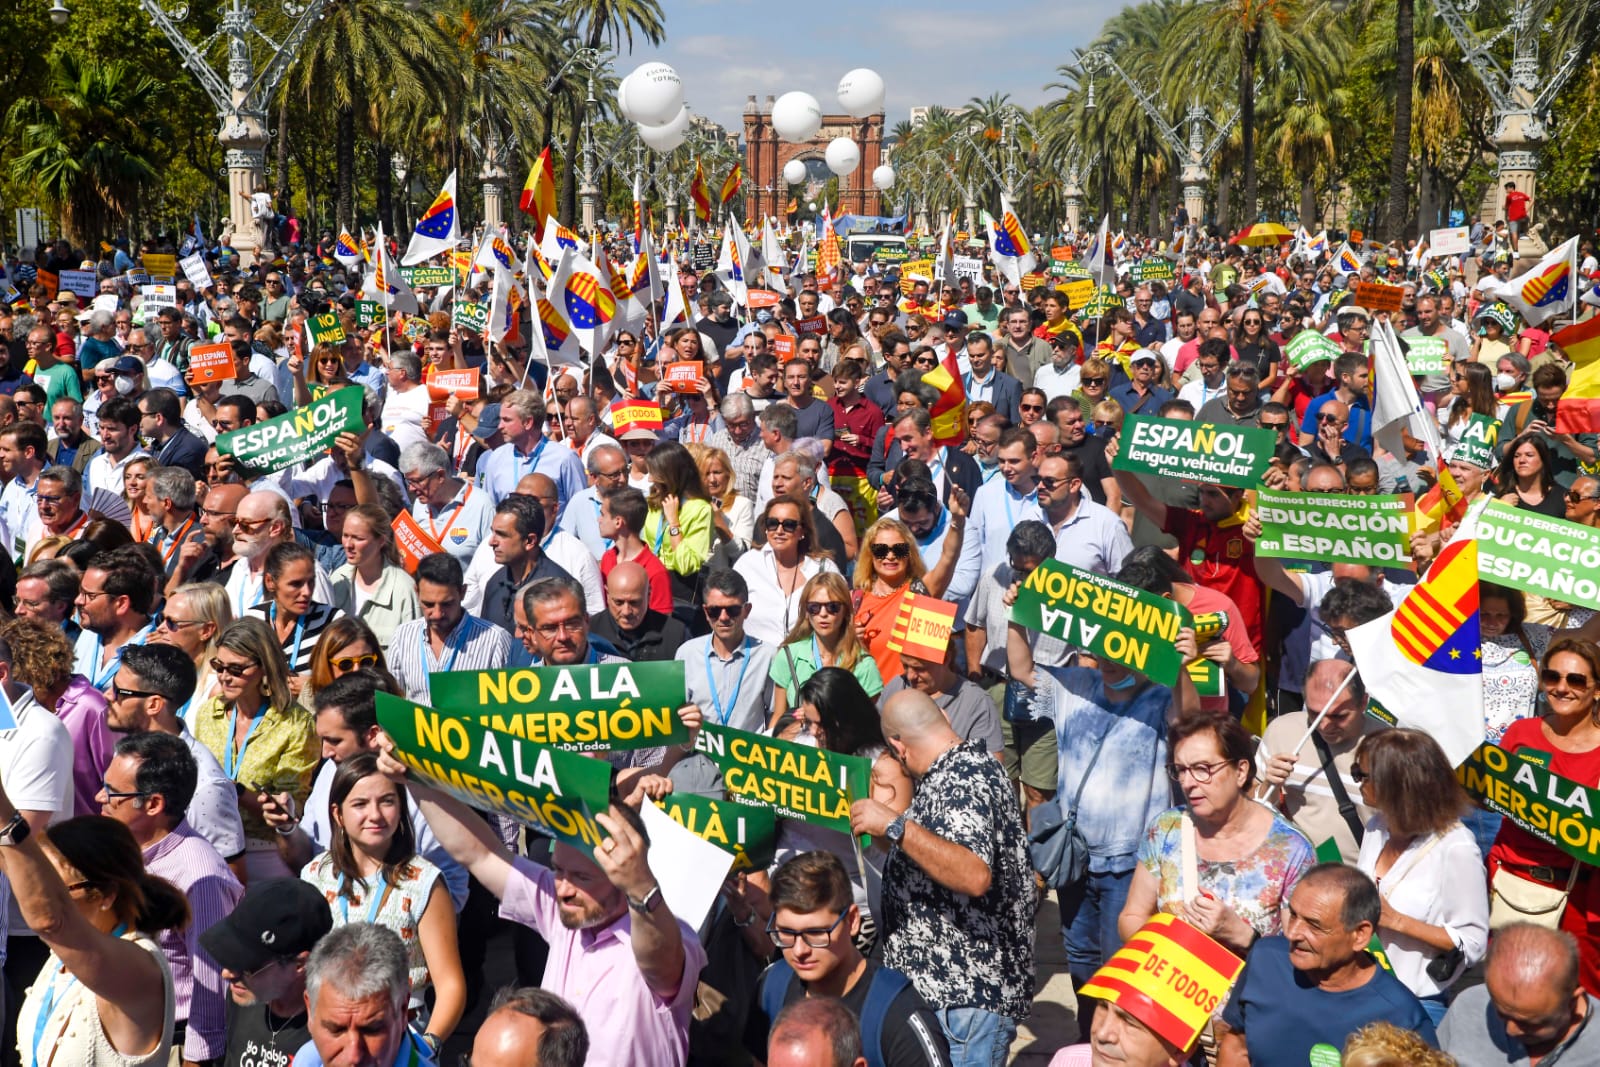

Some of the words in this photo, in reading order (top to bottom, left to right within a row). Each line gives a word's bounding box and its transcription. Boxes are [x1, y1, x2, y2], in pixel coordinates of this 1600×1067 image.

[317, 314, 335, 328] NO
[361, 304, 373, 312] EN
[361, 314, 372, 322] EN
[1406, 359, 1448, 371] AÑOL
[232, 398, 348, 457] ESPAÑOL,
[615, 412, 626, 424] DE
[237, 447, 287, 468] lengua
[289, 416, 348, 453] vehicular
[272, 443, 328, 471] #EscuelaDeTodos
[1131, 423, 1256, 463] ESPAÑOL,
[1128, 445, 1178, 467] lengua
[1181, 455, 1253, 477] vehicular
[1158, 467, 1221, 484] #EscuelaDeTodos
[1258, 490, 1304, 505] Tenemos
[1307, 497, 1367, 509] DERECHO
[1381, 501, 1406, 509] una
[1258, 506, 1409, 533] EDUCACIÓN
[1523, 516, 1588, 540] DERECHO
[1260, 539, 1280, 550] en
[1282, 533, 1413, 562] ESPAÑOL
[1476, 521, 1600, 568] DUCACIÓ
[1072, 568, 1139, 598] #EscuelaDeTodos
[1024, 567, 1182, 642] INMERSIÓN
[910, 617, 921, 633] DE
[1040, 602, 1073, 639] LA
[1079, 619, 1101, 647] A
[1104, 631, 1150, 670] NO
[479, 670, 541, 704] NO
[550, 669, 581, 702] A
[590, 666, 641, 700] LA
[464, 699, 673, 744] MERSIÓN
[414, 708, 470, 760] NO
[479, 730, 508, 776] A
[512, 739, 563, 796] LA
[694, 729, 725, 757] EN
[730, 739, 833, 787] CATALÀ
[840, 765, 847, 790] I
[399, 750, 602, 846] INMERSIÓN
[725, 767, 852, 820] CASTELLÀ
[1513, 762, 1539, 794] A
[1547, 774, 1593, 818] LA
[737, 817, 746, 845] I
[1143, 953, 1165, 979] DE
[1166, 966, 1218, 1014] TODOS
[260, 1044, 288, 1065] hablo
